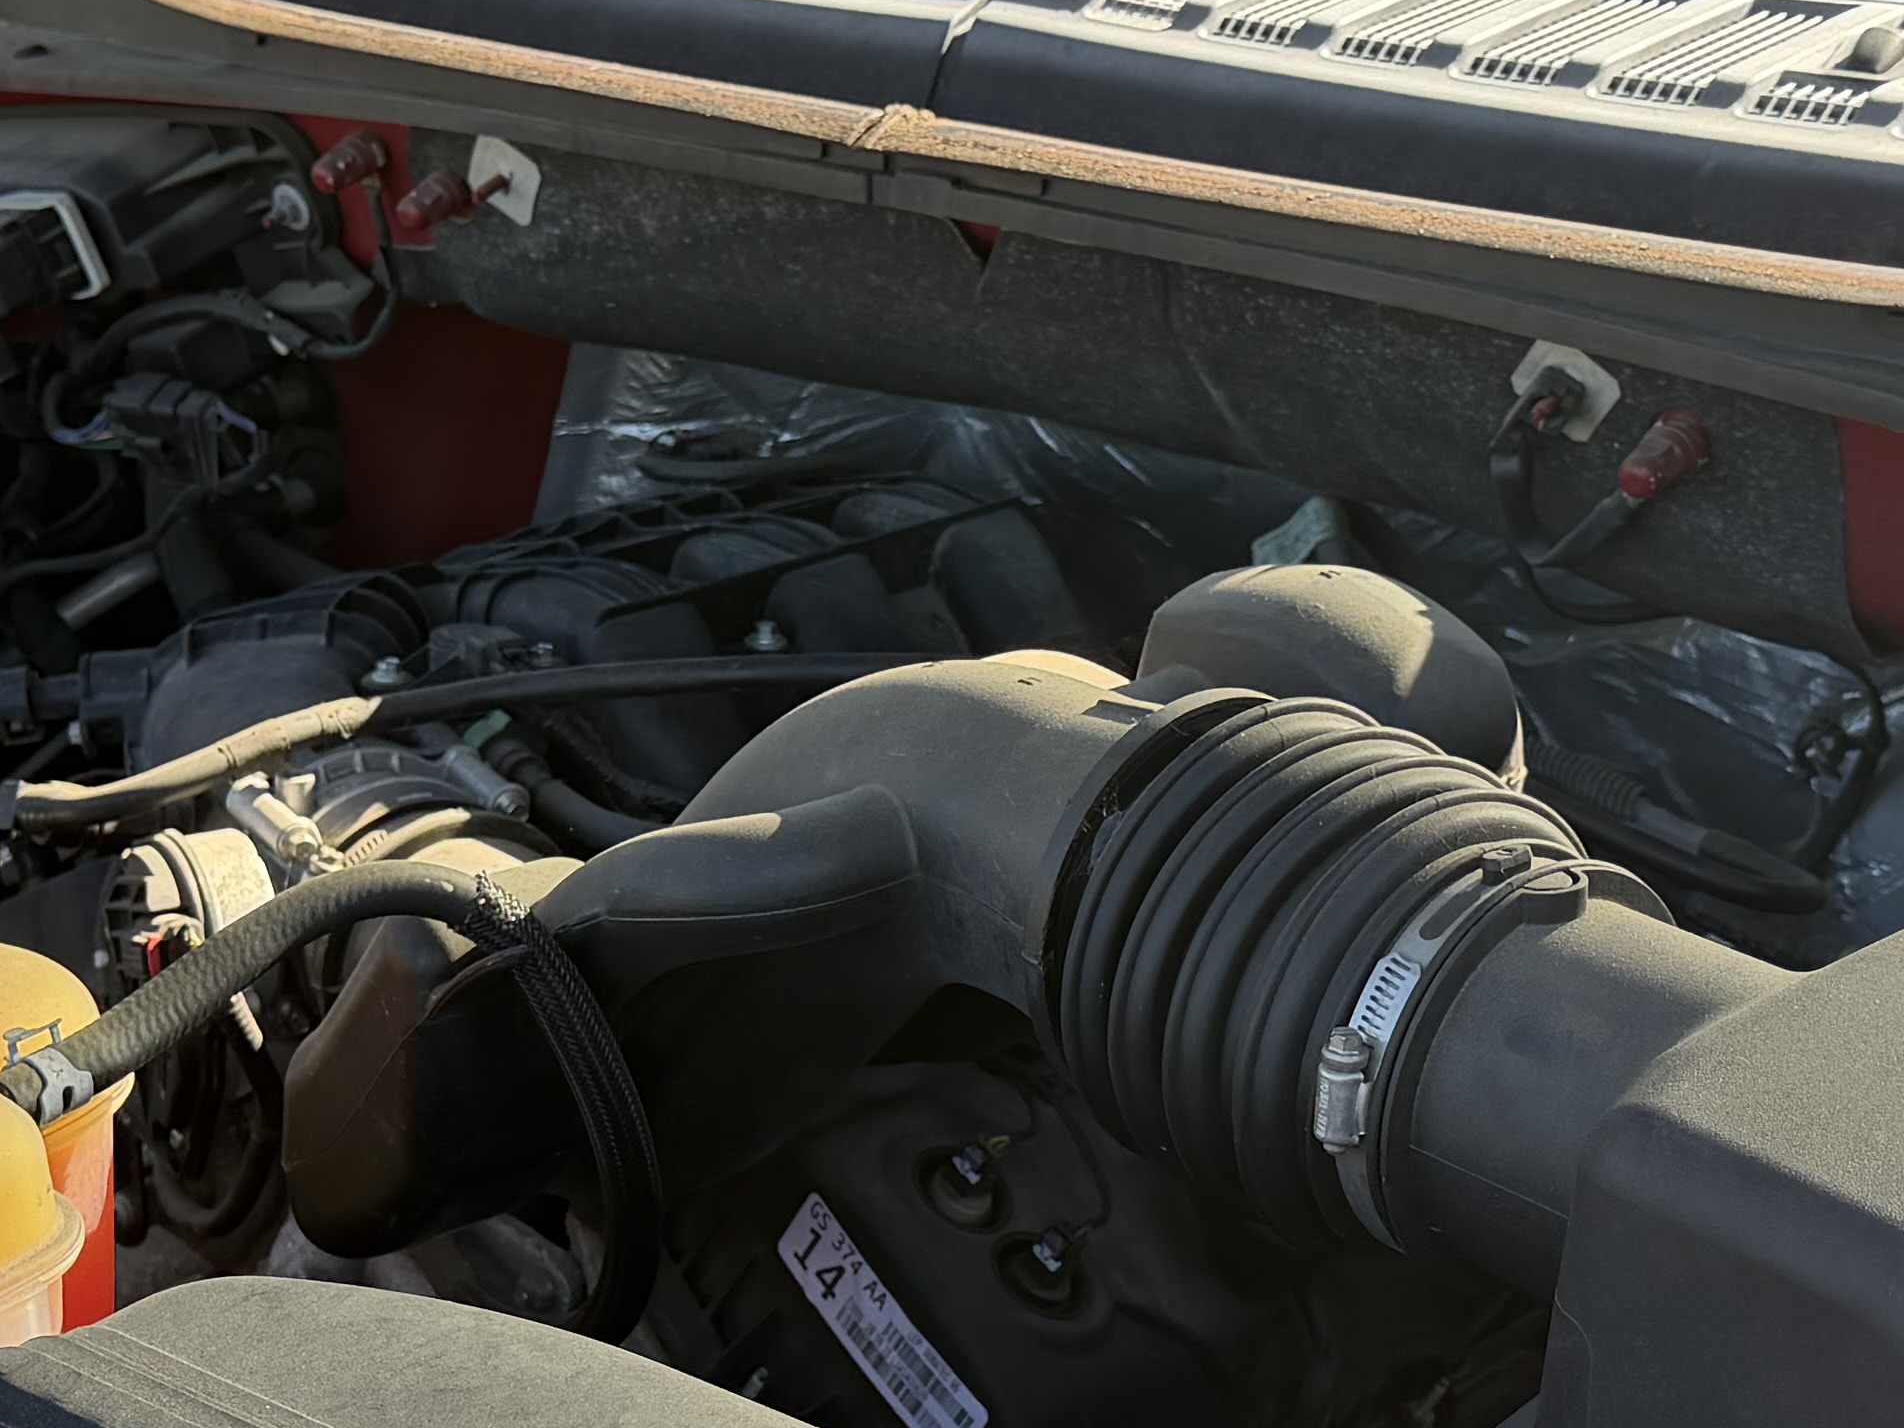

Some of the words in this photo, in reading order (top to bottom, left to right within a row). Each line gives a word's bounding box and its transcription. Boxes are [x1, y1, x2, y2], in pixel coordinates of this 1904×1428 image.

[793, 1227, 846, 1300] 14
[810, 1201, 831, 1232] GS
[832, 1235, 863, 1275] 374
[863, 1280, 887, 1311] AA
